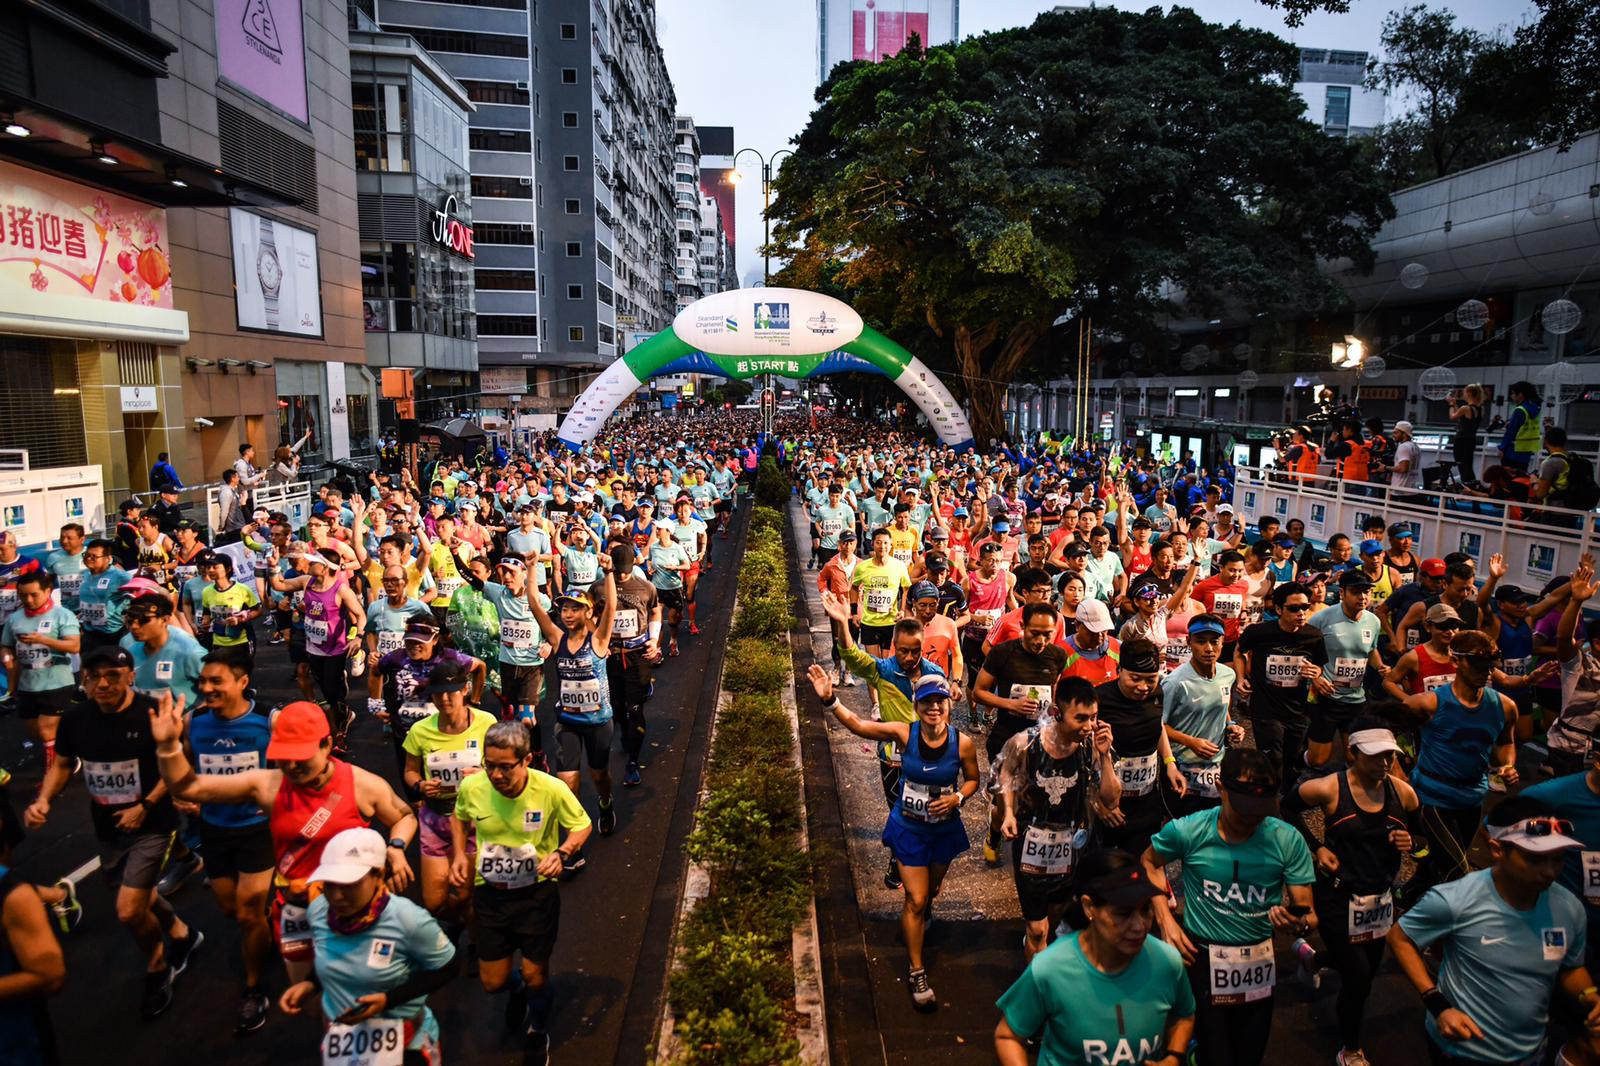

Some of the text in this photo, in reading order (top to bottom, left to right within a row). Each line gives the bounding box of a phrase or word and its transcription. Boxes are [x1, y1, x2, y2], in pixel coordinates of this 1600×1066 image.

[0, 204, 87, 259] 豬迎春
[432, 194, 475, 258] The ONE
[750, 361, 786, 370] START
[868, 595, 891, 604] B3270
[502, 627, 531, 639] B3526
[562, 692, 599, 704] B0010
[89, 772, 136, 788] A5404
[1027, 841, 1070, 858] B4726
[481, 856, 535, 874] B5370
[1203, 879, 1267, 904] RAN
[1214, 963, 1273, 988] B0487
[327, 1028, 398, 1058] B2089
